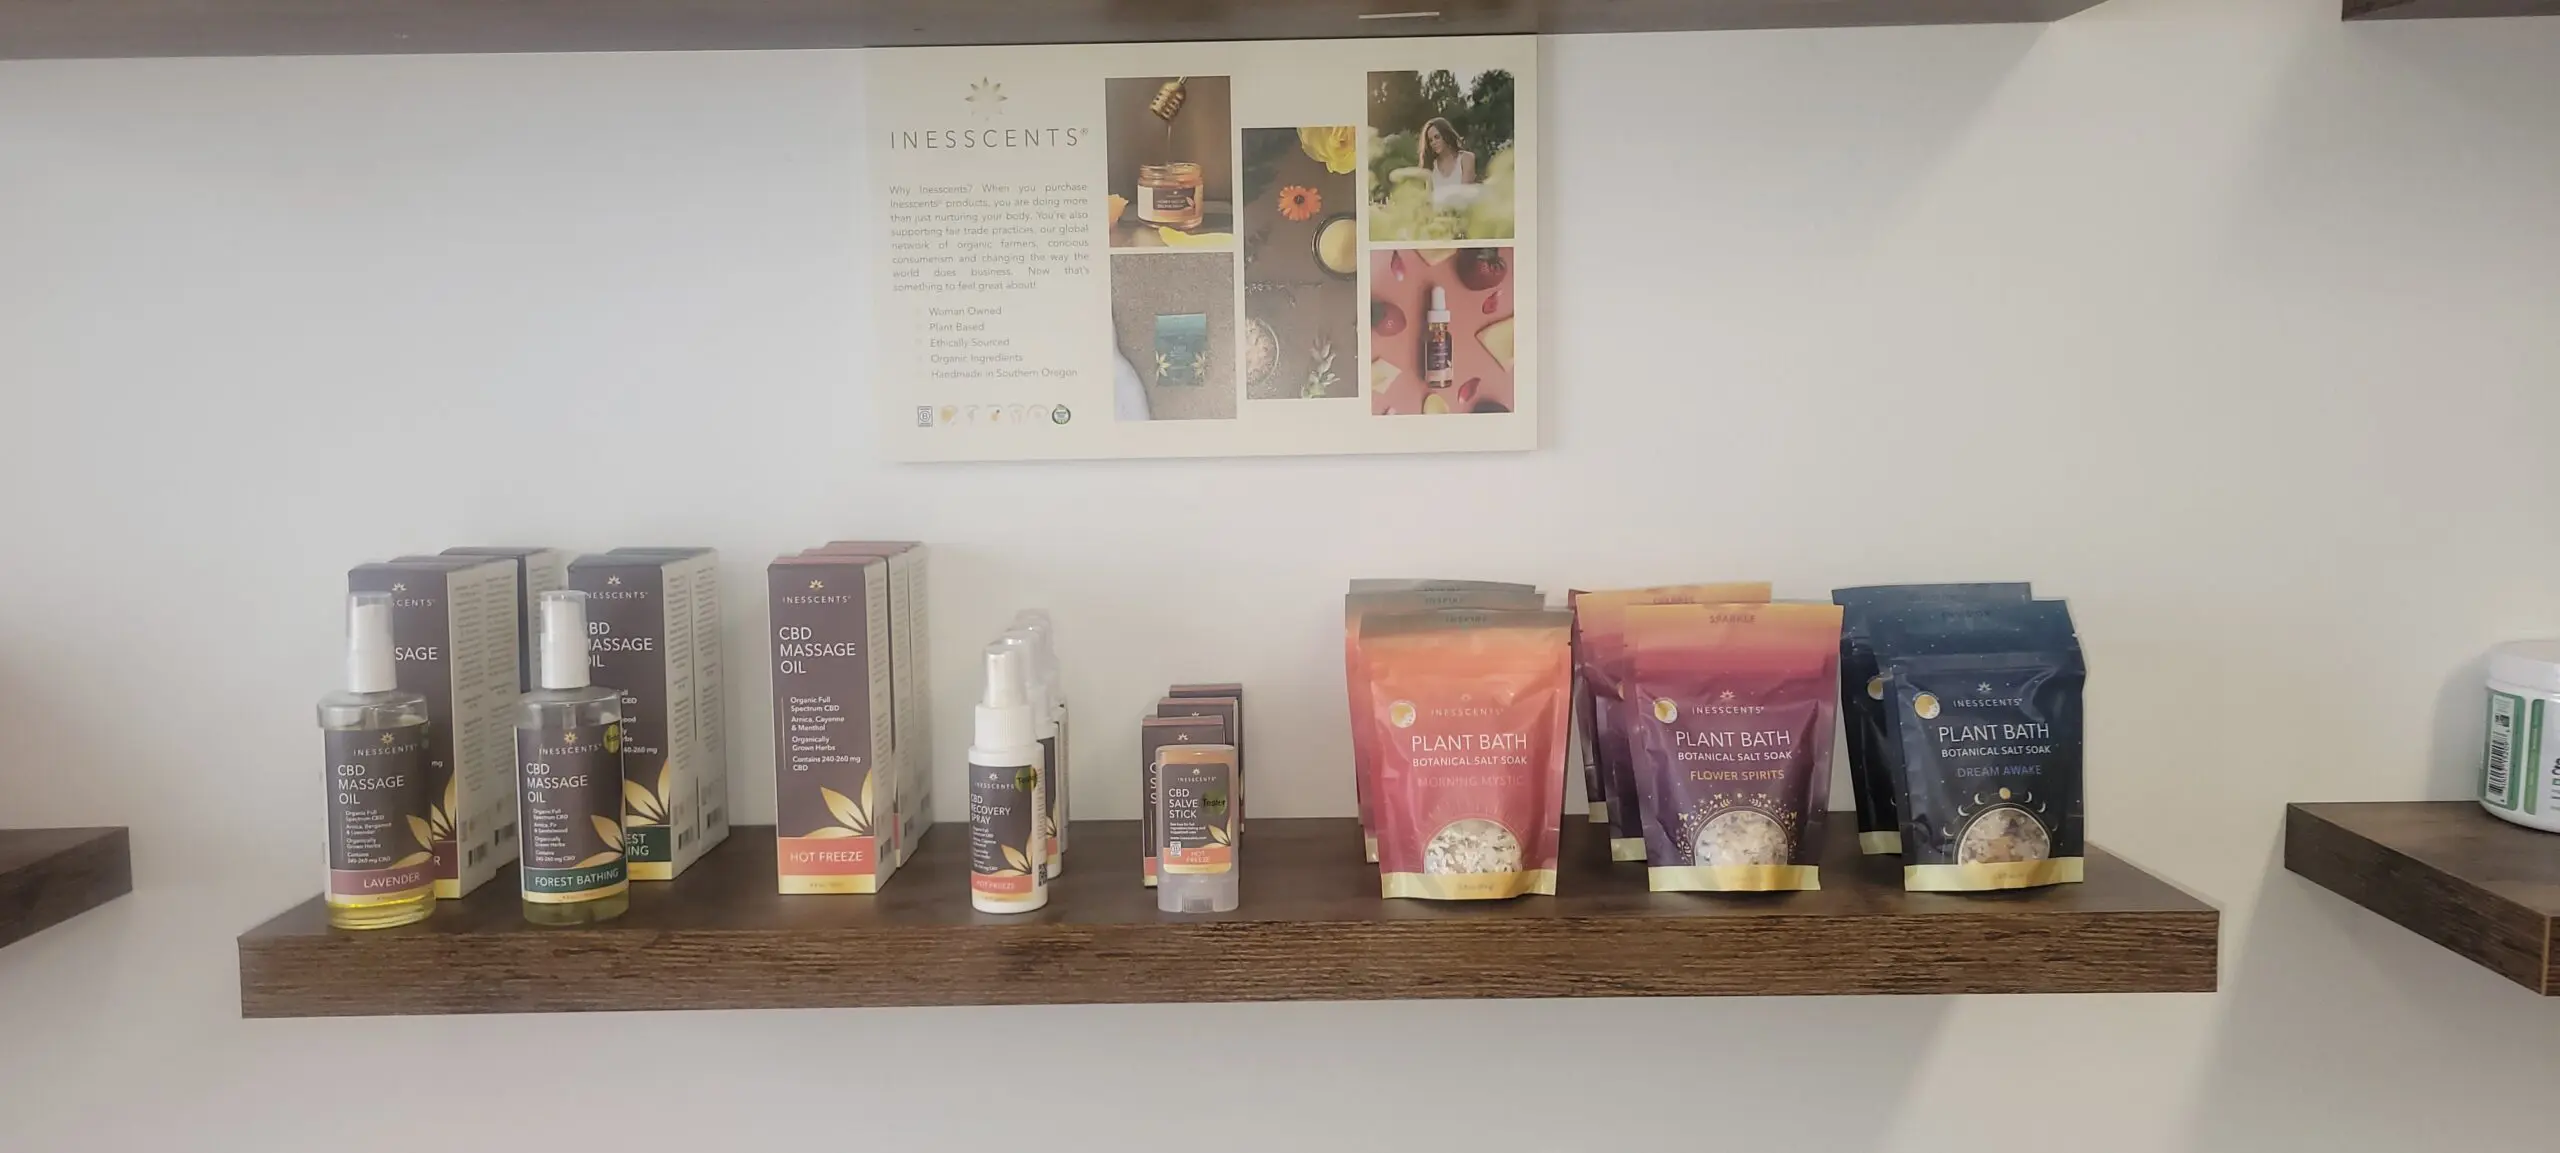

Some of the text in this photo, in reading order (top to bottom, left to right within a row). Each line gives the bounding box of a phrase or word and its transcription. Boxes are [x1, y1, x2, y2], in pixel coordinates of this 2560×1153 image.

[889, 184, 1087, 195] Why Inesscents? When you purchase
[1033, 197, 1060, 207] doing
[890, 214, 911, 222] than
[915, 214, 931, 223] just
[934, 214, 978, 222] nurturing
[982, 213, 1001, 222] your
[890, 227, 943, 236] supporting
[945, 227, 960, 235] fair
[964, 226, 988, 235] trade
[1058, 224, 1089, 235] global
[892, 241, 929, 249] network
[939, 240, 948, 249] of
[957, 241, 992, 250] organic
[892, 252, 1089, 264] consumerism and changing the way the
[893, 268, 920, 277] world
[1028, 266, 1050, 276] Now
[893, 282, 943, 292] something
[945, 283, 955, 291] to
[958, 281, 976, 290] feel
[978, 281, 1003, 292] great
[928, 306, 1002, 316] Woman Owned
[929, 322, 985, 332] Plant Based
[930, 337, 1010, 348] Ethically Sourced
[930, 353, 1023, 365] Organic Ingredients
[931, 368, 1078, 379] Handmade in Southern Oregon
[1709, 614, 1757, 624] SPARKLE
[589, 622, 610, 635] BD
[779, 626, 812, 640] CBD
[588, 638, 653, 651] ASSAGE
[780, 643, 856, 657] MASSAGE
[395, 646, 439, 660] SAGE
[780, 660, 807, 674] OIL
[790, 696, 817, 705] Organic
[790, 704, 840, 713] Spectrum CBD
[815, 715, 845, 725] Cayenne
[1675, 730, 1791, 748] PLANT BATH
[1938, 723, 2049, 743] PLANT BATH
[792, 735, 830, 744] Organically
[1411, 733, 1527, 752] PLANT BATH
[1678, 751, 1793, 762] BOTANICAL SALT SOAK
[1941, 745, 2051, 758] BOTANICAL SALT SOAK
[1413, 755, 1527, 767] BOTANICAL SALT SOAK
[337, 764, 365, 776] CBD
[526, 762, 550, 775] CBD
[793, 764, 809, 772] CBD
[1957, 765, 2042, 778] DREAM AWAKE
[1690, 769, 1785, 781] FLOWER SPIRITS
[338, 775, 405, 790] MASSAGE
[527, 774, 588, 789] MASSAGE
[1418, 775, 1525, 788] MORNING MYSTIC
[339, 792, 361, 805] OIL
[527, 791, 546, 803] OIL
[1168, 788, 1190, 798] CBD
[1169, 799, 1199, 808] SALVE
[1202, 798, 1226, 807] Tester
[970, 804, 1011, 816] RECOVERY
[1169, 809, 1197, 819] STICK
[971, 812, 991, 825] SPRAY
[625, 834, 646, 844] EST
[790, 851, 863, 863] HOT FREEZE
[363, 872, 420, 889] LAVENDER
[535, 868, 620, 887] FOREST BATHING
